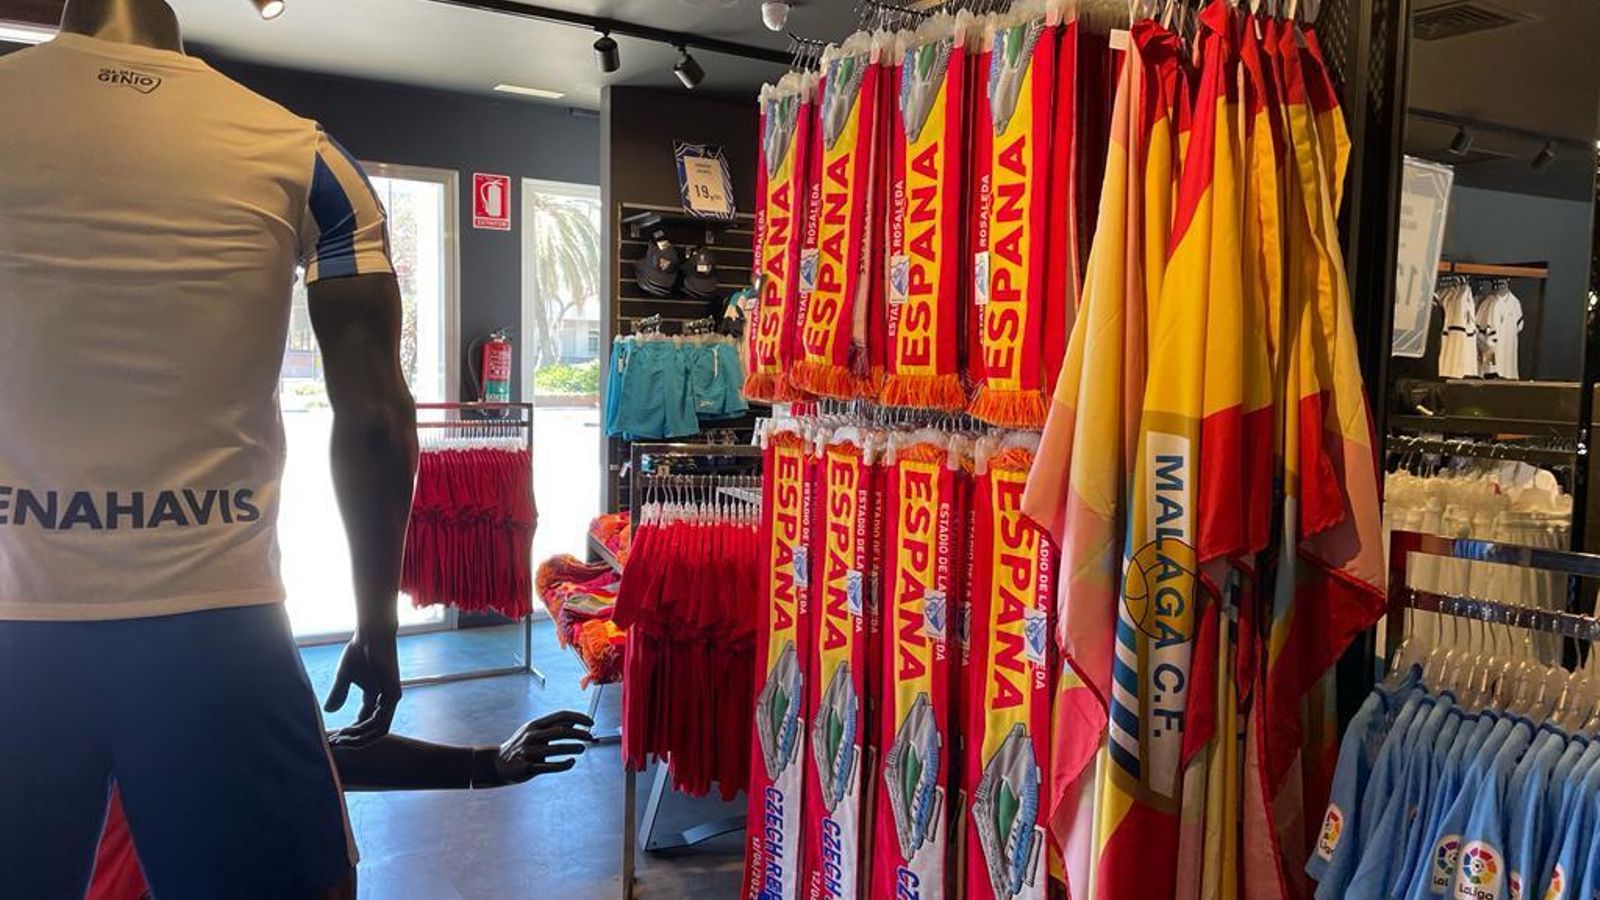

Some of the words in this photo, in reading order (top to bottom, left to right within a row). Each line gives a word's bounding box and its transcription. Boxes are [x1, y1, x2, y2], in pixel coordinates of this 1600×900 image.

[97, 73, 153, 86] GENIO
[892, 180, 904, 248] ROSALEDA
[978, 174, 990, 247] ROSALEDA
[755, 209, 765, 266] ROSALEDA
[796, 292, 808, 326] ESTAD
[807, 184, 820, 245] ROSALEDA
[0, 486, 260, 530] NAHAVIS
[858, 490, 867, 535] ESTADIO
[939, 502, 950, 554] ESTADIO
[802, 527, 810, 541] DE
[857, 538, 866, 553] DE
[1040, 537, 1050, 570] ADIO
[856, 555, 865, 570] LA
[937, 575, 948, 592] LA
[938, 556, 948, 573] DE
[1039, 574, 1049, 592] DE
[1038, 595, 1048, 612] LA
[1153, 663, 1185, 738] C.F.
[765, 787, 783, 859] CZECH
[822, 817, 842, 898] CZECH
